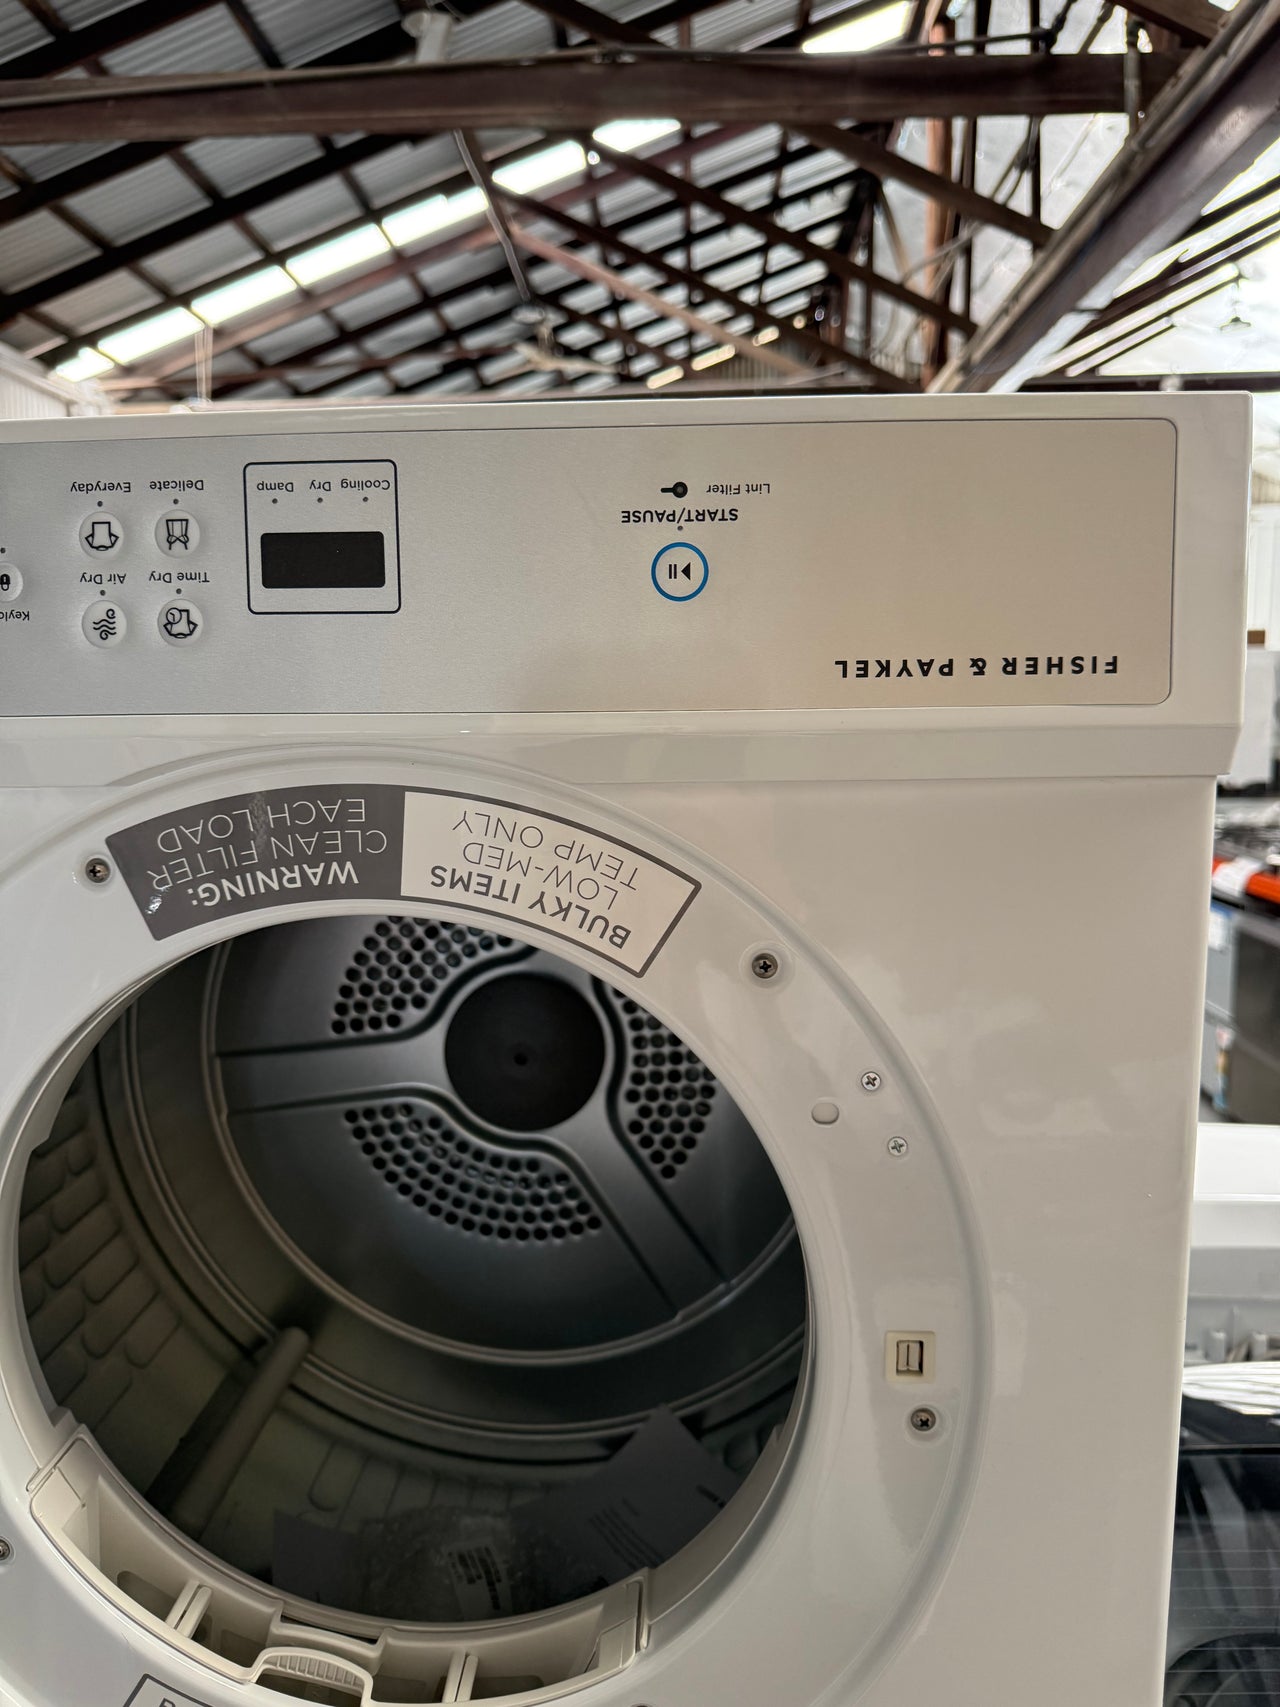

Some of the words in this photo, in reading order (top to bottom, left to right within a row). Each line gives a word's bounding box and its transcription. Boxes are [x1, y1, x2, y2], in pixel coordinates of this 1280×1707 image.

[70, 480, 132, 494] Everyday
[149, 480, 205, 492] Delicate
[256, 480, 294, 493] Damp
[309, 480, 332, 493] Dry
[340, 478, 391, 492] Cooling
[706, 483, 741, 495] Filter
[746, 483, 771, 495] Lint
[621, 507, 739, 524] START/PAUSE
[80, 572, 106, 585] Dry
[109, 573, 127, 584] Air
[148, 570, 172, 584] Dry
[177, 572, 210, 583] Time
[833, 658, 954, 678] PAYKEL
[968, 657, 987, 676] &
[1000, 655, 1118, 676] FISHER
[268, 798, 366, 827] EACH
[156, 808, 254, 854] LOAD
[451, 809, 544, 849] ONLY
[271, 828, 387, 855] CLEAN
[146, 839, 257, 889] FILTER
[553, 838, 639, 892] TEMP
[185, 860, 359, 907] WARNING:
[429, 864, 522, 904] ITEMS
[462, 840, 620, 909] LOW-MED
[529, 889, 631, 949] BULKY
